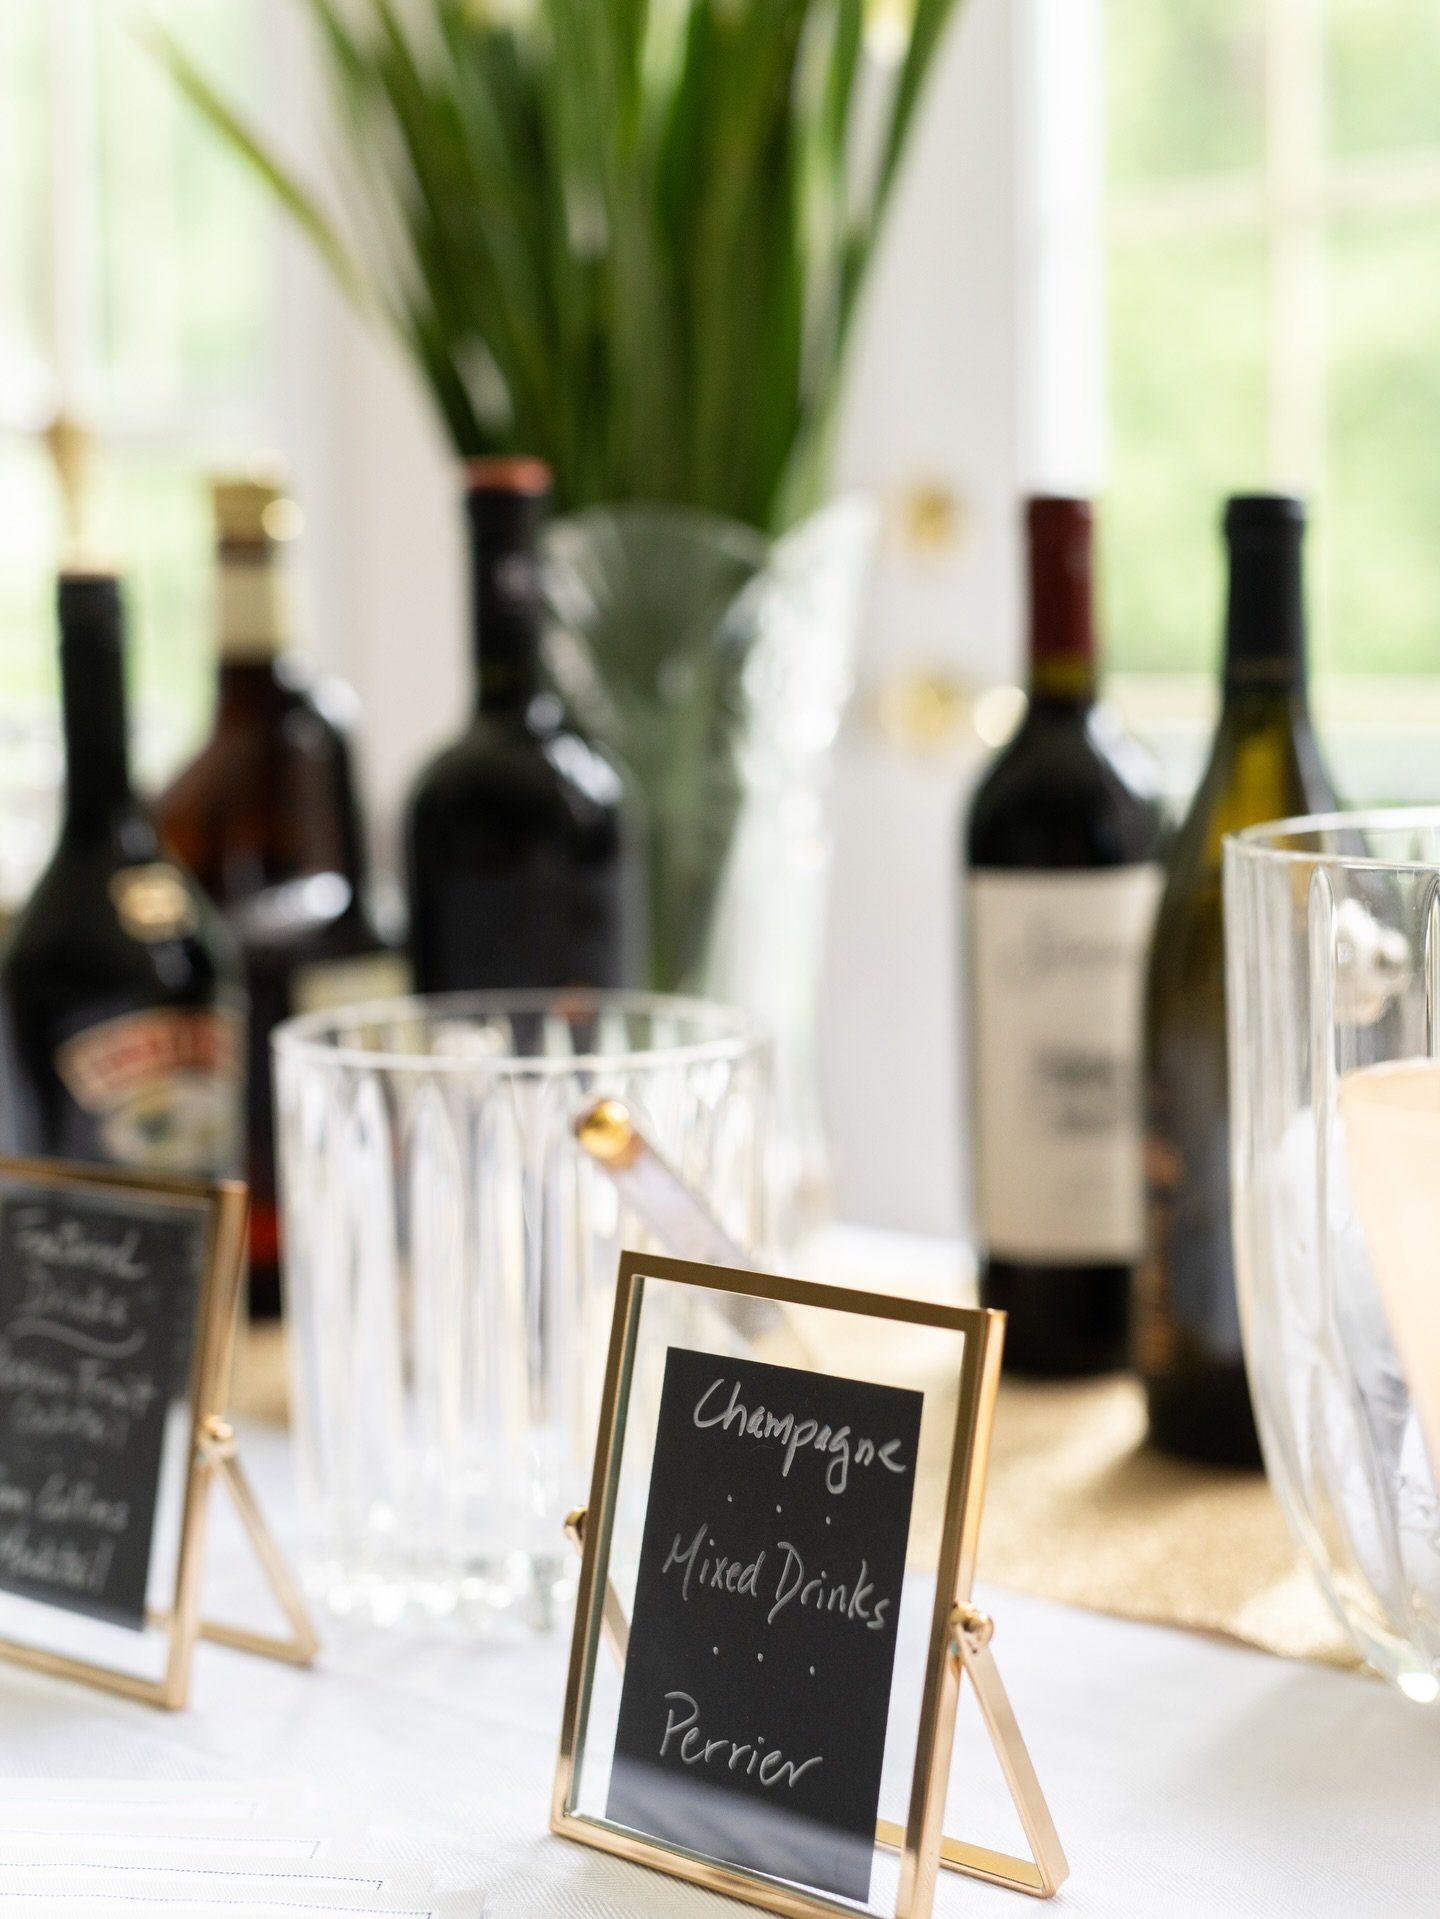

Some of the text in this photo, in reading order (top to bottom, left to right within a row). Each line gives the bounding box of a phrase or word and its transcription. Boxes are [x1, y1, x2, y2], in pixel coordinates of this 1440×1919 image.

[693, 1378, 907, 1494] Champagne
[662, 1522, 890, 1630] Mixed Drinks
[659, 1691, 823, 1788] Perrier
